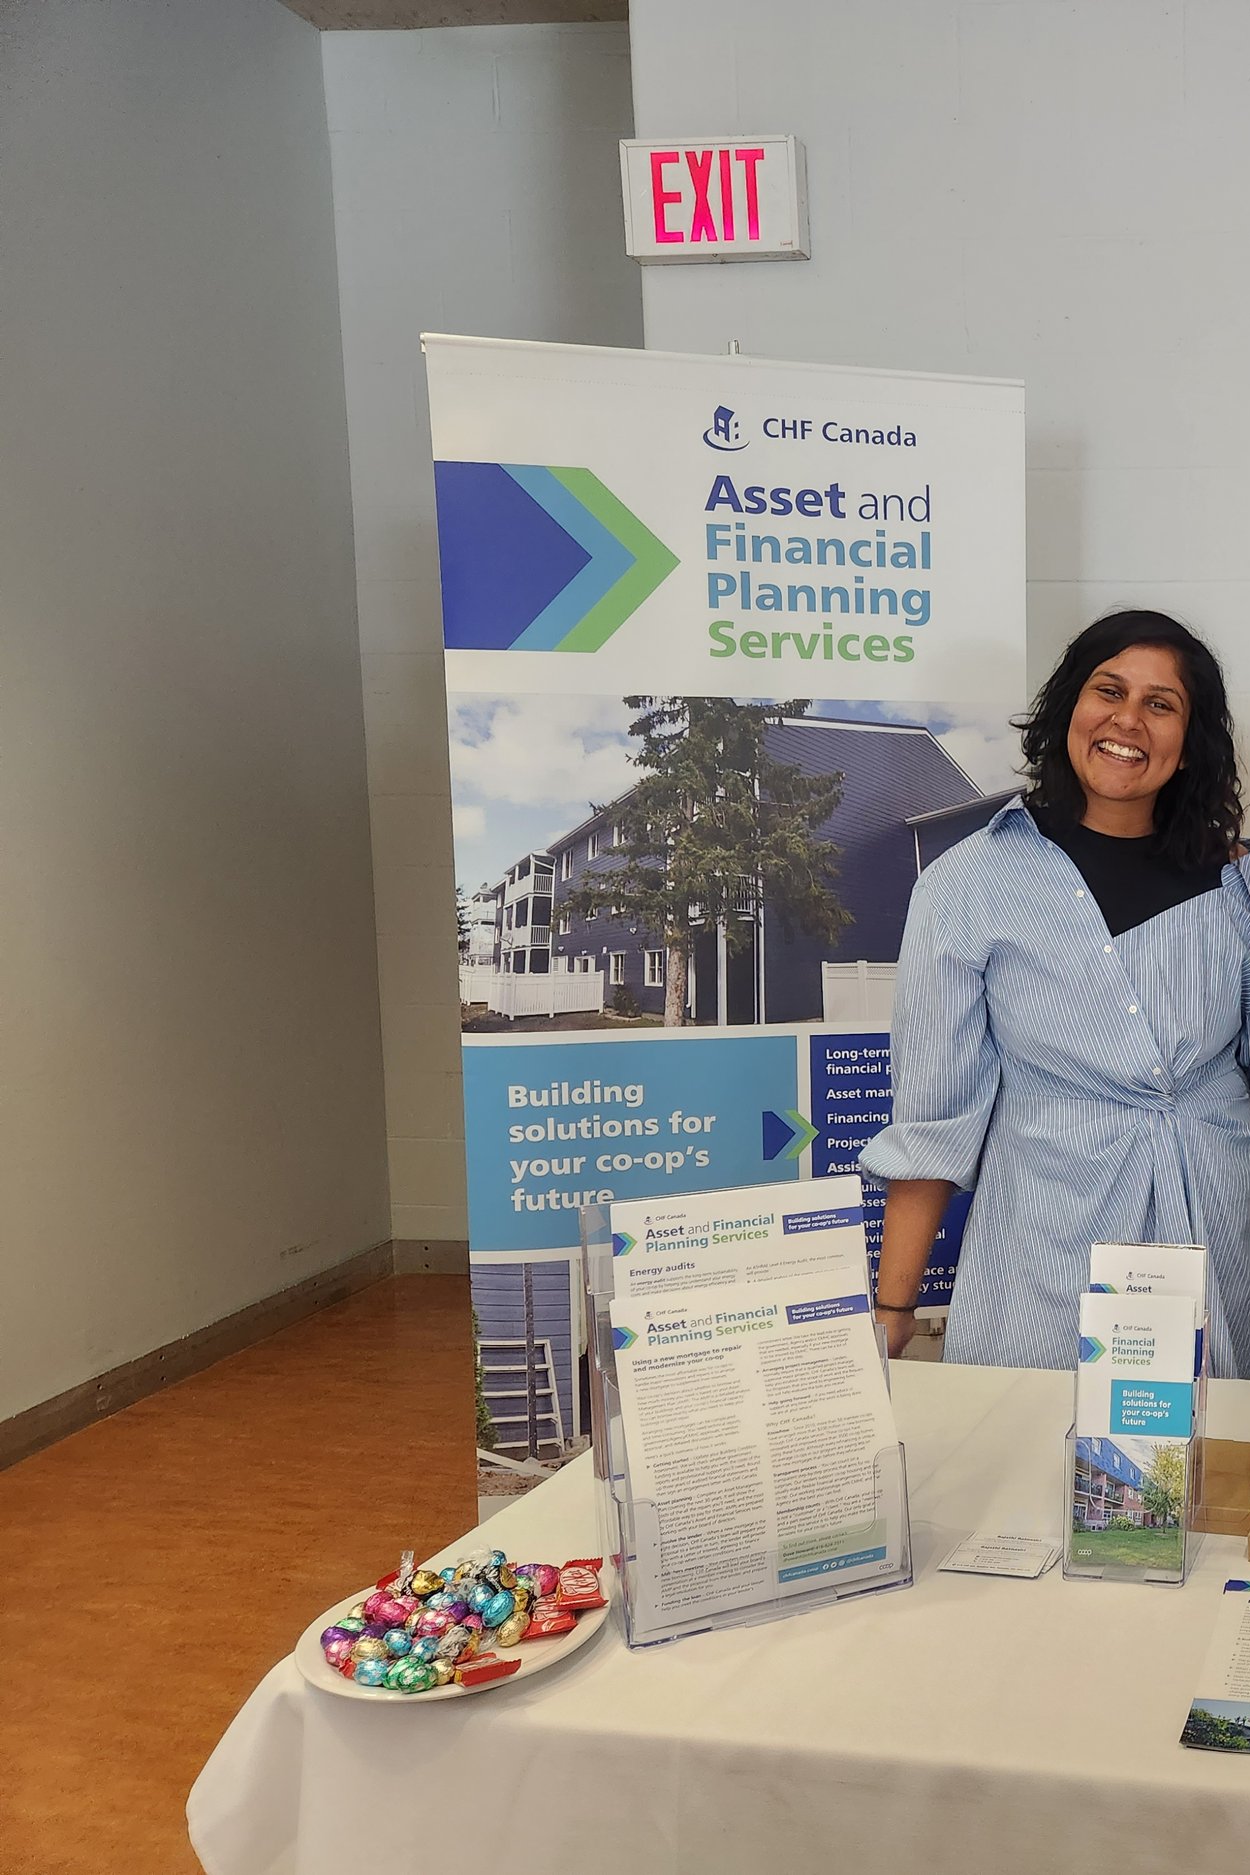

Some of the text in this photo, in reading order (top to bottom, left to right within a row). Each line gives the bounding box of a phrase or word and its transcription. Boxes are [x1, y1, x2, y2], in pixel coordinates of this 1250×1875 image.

[650, 148, 764, 243] EXIT
[763, 418, 917, 448] CHF Canada
[704, 475, 930, 523] Asset and
[706, 523, 932, 570] Financial
[707, 572, 932, 627] Planning
[708, 621, 915, 664] Services
[826, 1048, 891, 1061] Long-term
[826, 1063, 881, 1075] financial
[508, 1080, 644, 1108] Building
[826, 1089, 861, 1099] Asset
[827, 1113, 889, 1125] Financing
[509, 1110, 717, 1143] solutions for
[828, 1138, 871, 1150] Projec
[510, 1146, 710, 1184] your co-op's
[510, 1188, 614, 1212] future
[788, 1216, 811, 1224] Building
[646, 1214, 774, 1240] Asset and Financial
[646, 1229, 769, 1253] Planning Services
[630, 1262, 695, 1277] Energy audits
[1126, 1285, 1152, 1293] Asset
[792, 1303, 840, 1315] Building solutions
[647, 1305, 778, 1334] Asset and Financial
[648, 1320, 773, 1346] Planning Services
[1113, 1337, 1155, 1346] Financial
[677, 1351, 710, 1359] mortgage
[722, 1345, 742, 1353] repair
[1112, 1347, 1155, 1358] Planning
[649, 1361, 685, 1370] modernize
[1112, 1356, 1151, 1365] Services
[1123, 1390, 1154, 1399] Building
[1123, 1400, 1157, 1408] solutions
[1142, 1411, 1169, 1419] co-op's
[1122, 1418, 1146, 1426] future
